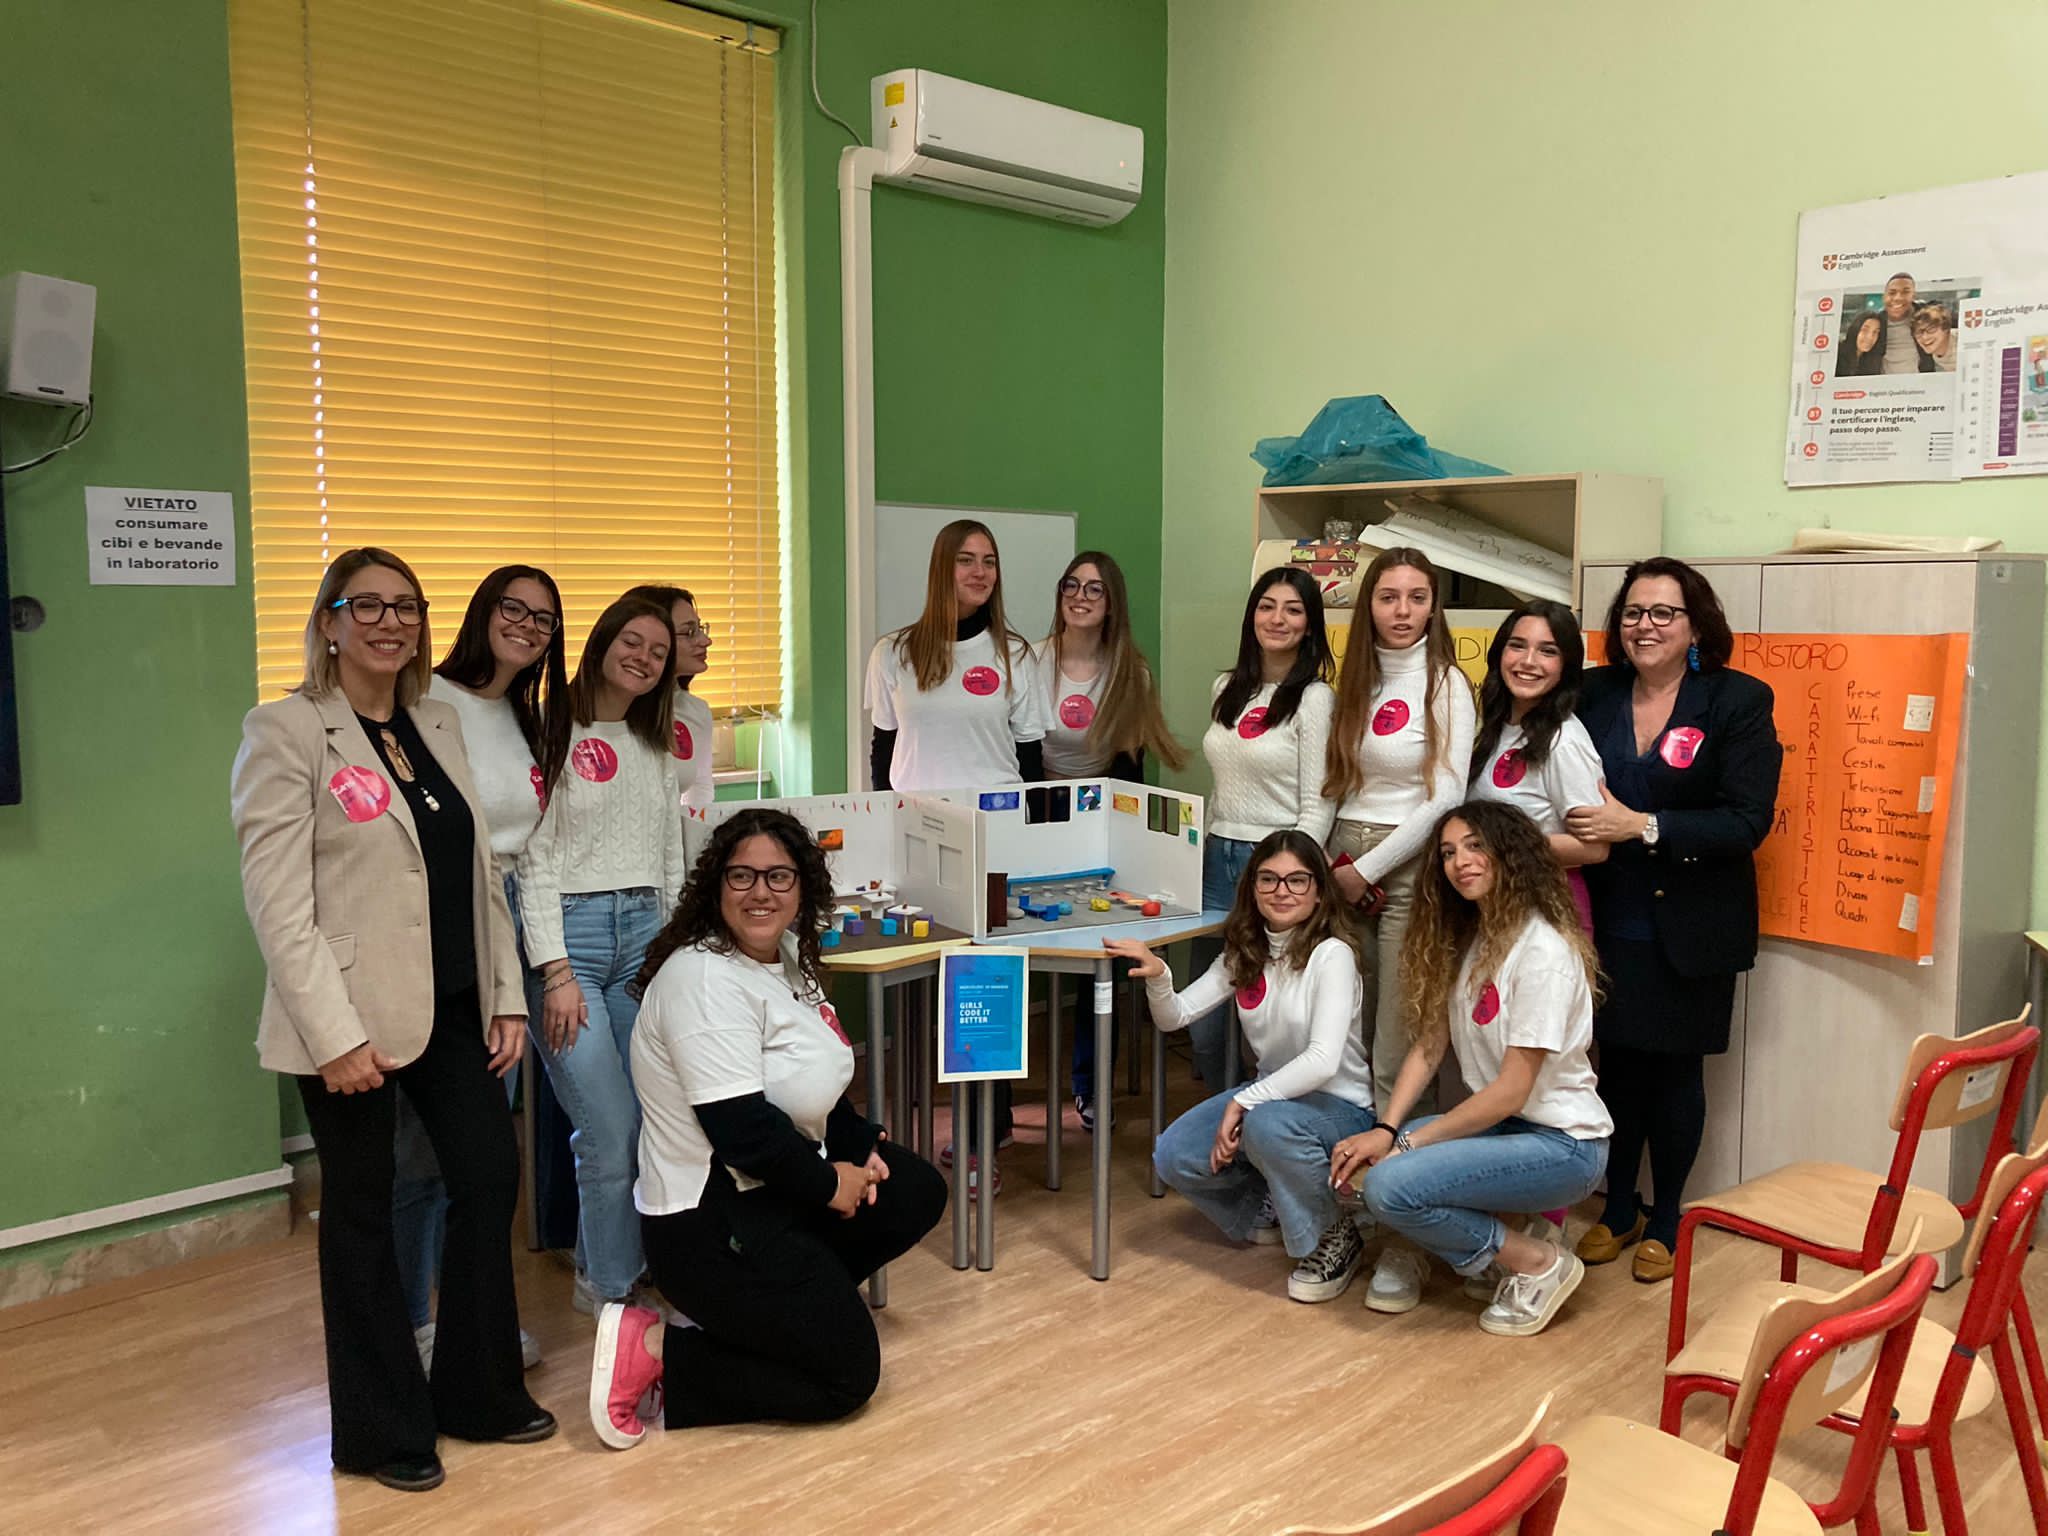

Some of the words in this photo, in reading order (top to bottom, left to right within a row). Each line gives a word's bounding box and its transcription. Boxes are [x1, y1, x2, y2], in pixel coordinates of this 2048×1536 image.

[1839, 251, 1880, 261] Cambridge
[1881, 246, 1927, 257] Assessment
[1838, 261, 1864, 271] English
[1984, 304, 2034, 315] Cambridge
[1984, 316, 2016, 328] English
[1840, 407, 1853, 415] tuo
[1854, 406, 1890, 417] percorso
[1891, 406, 1905, 417] per
[1906, 404, 1945, 414] imparare
[1836, 415, 1878, 424] certificare
[1829, 427, 1853, 435] passo
[1854, 425, 1875, 435] dopo
[1876, 425, 1902, 435] passo.
[124, 496, 198, 511] VIETATO
[115, 518, 209, 531] consumare
[101, 537, 133, 550] cibi
[138, 538, 149, 550] e
[154, 537, 223, 551] bevande
[107, 557, 123, 570] in
[128, 557, 219, 570] laboratorio
[1847, 679, 1880, 699] Prese
[959, 1001, 983, 1009] GIRLS
[983, 1008, 991, 1016] IT
[959, 1016, 988, 1024] BETTER
